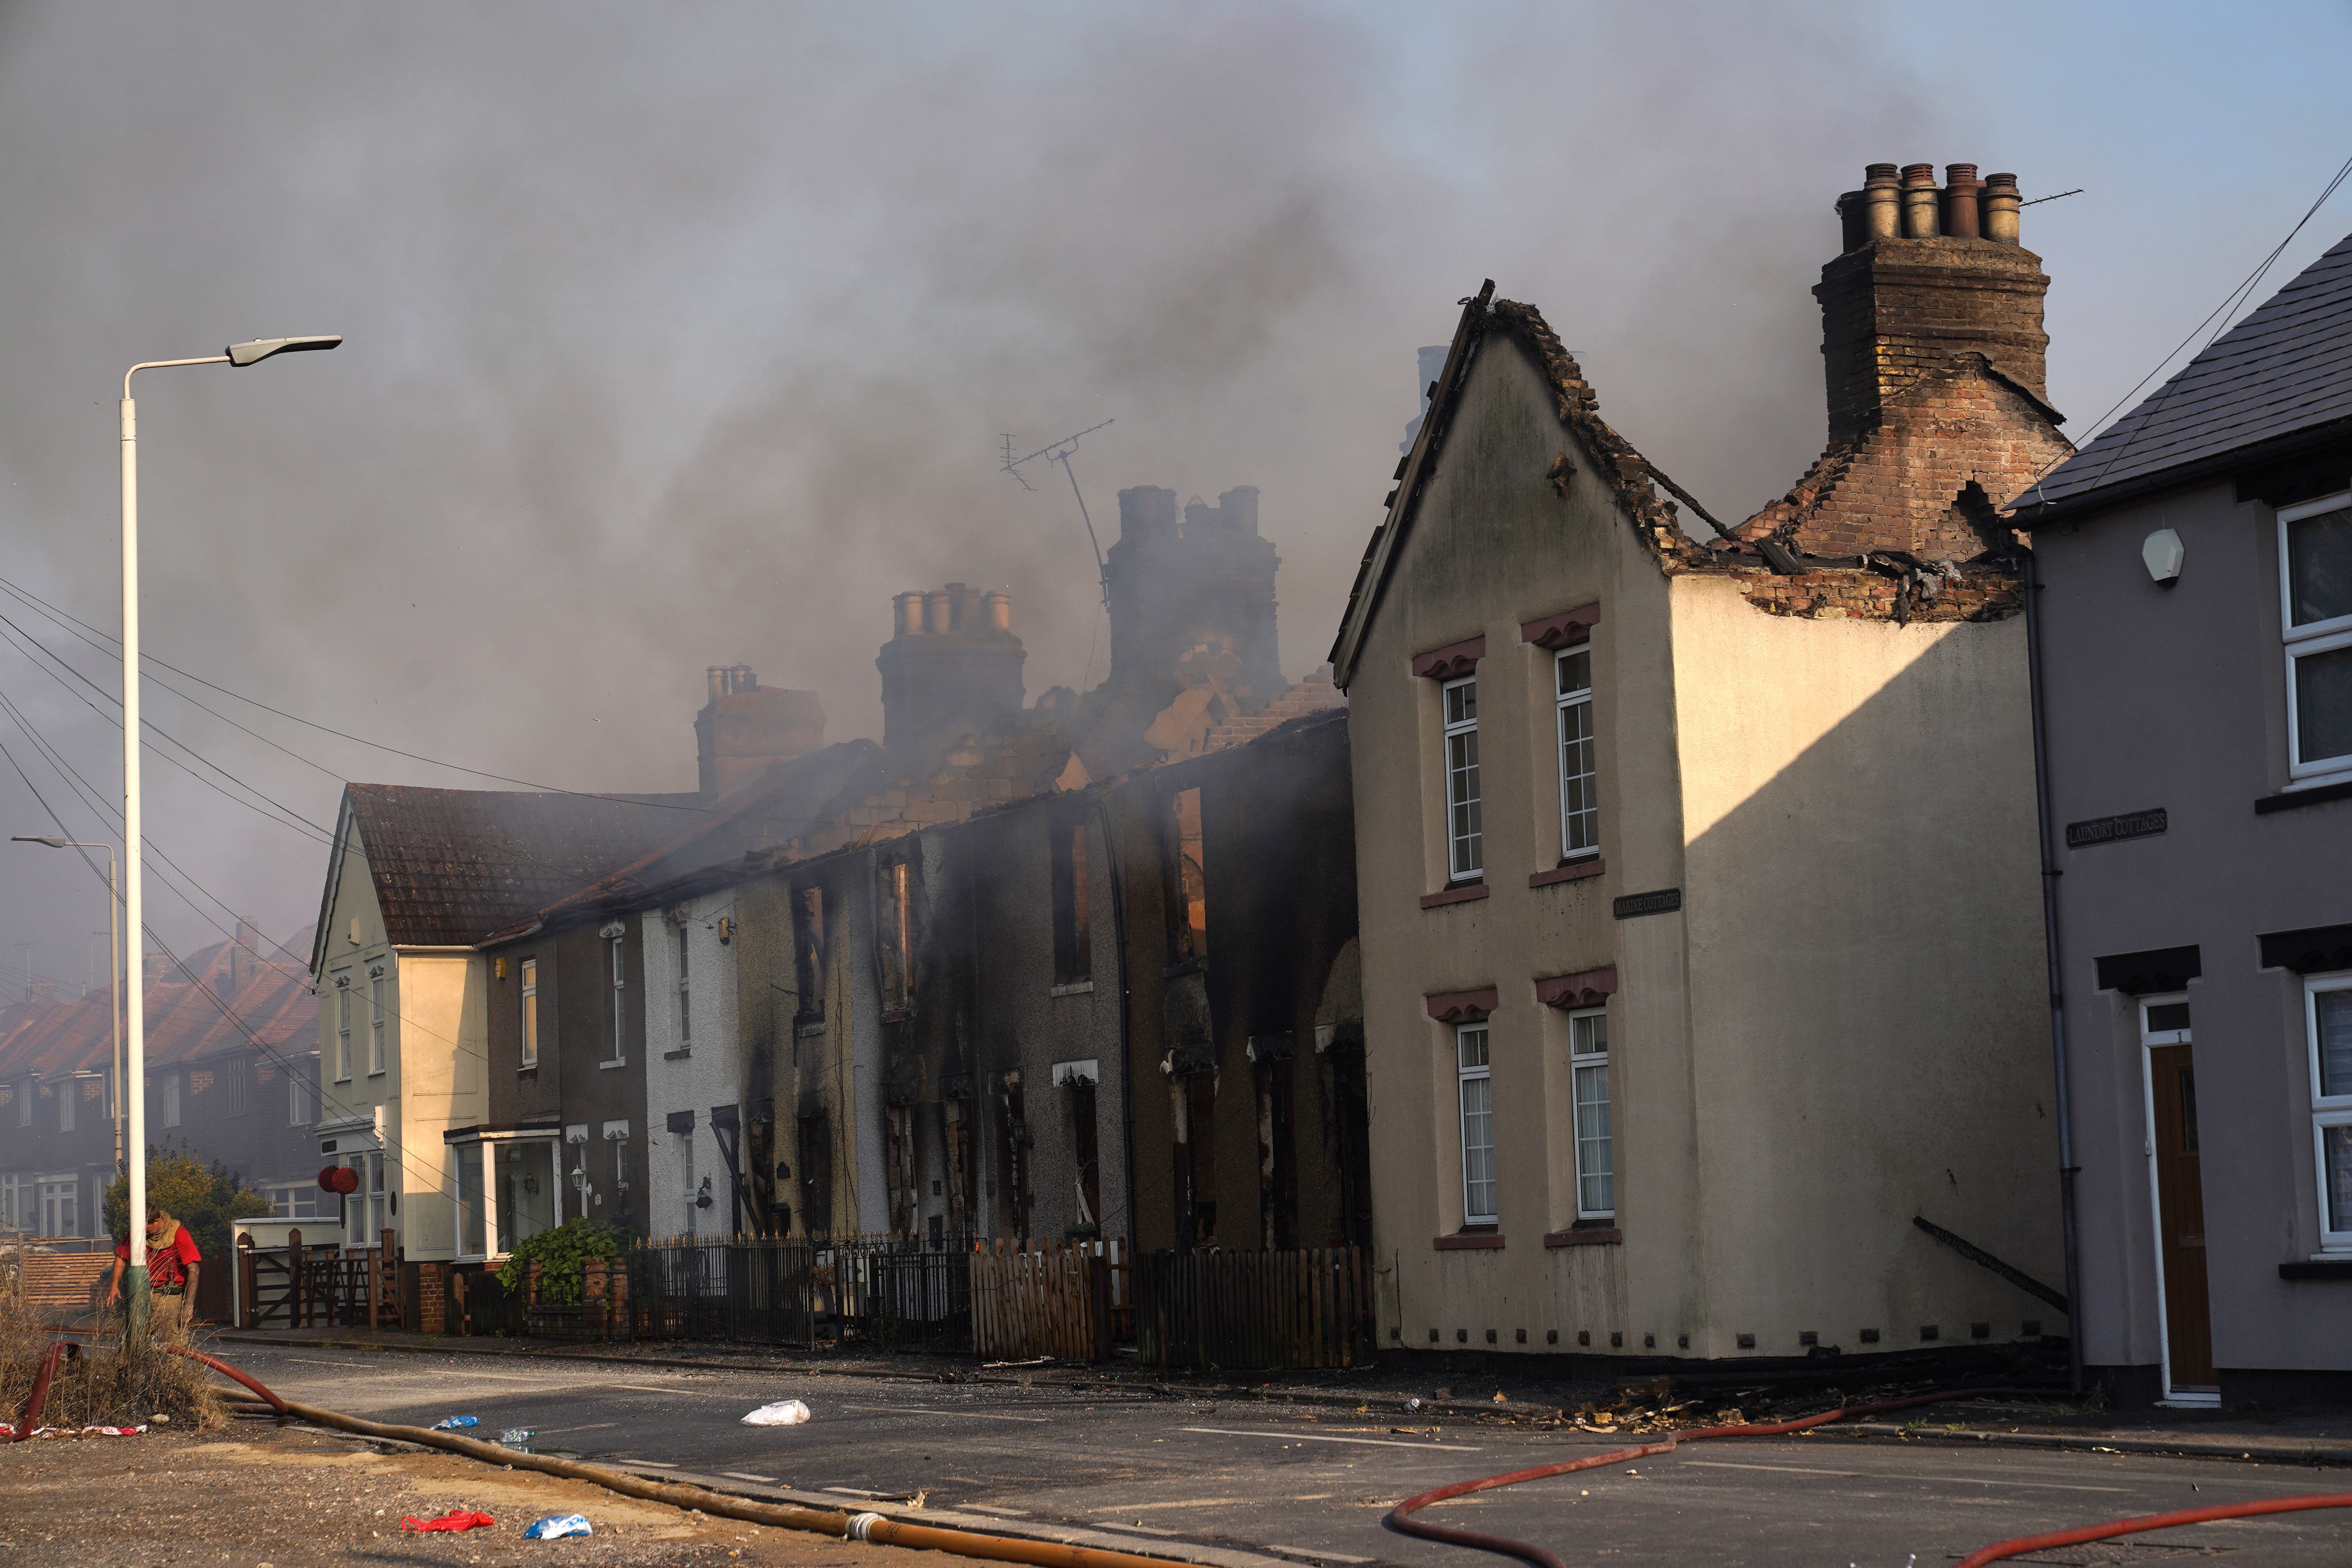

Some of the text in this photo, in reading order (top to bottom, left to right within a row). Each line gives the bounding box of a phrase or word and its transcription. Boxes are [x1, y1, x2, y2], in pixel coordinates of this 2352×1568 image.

[2069, 813, 2164, 843] LAUNDRY COTTAGES
[1616, 893, 1679, 914] MARINE COTTAGES
[2177, 1031, 2183, 1043] 1
